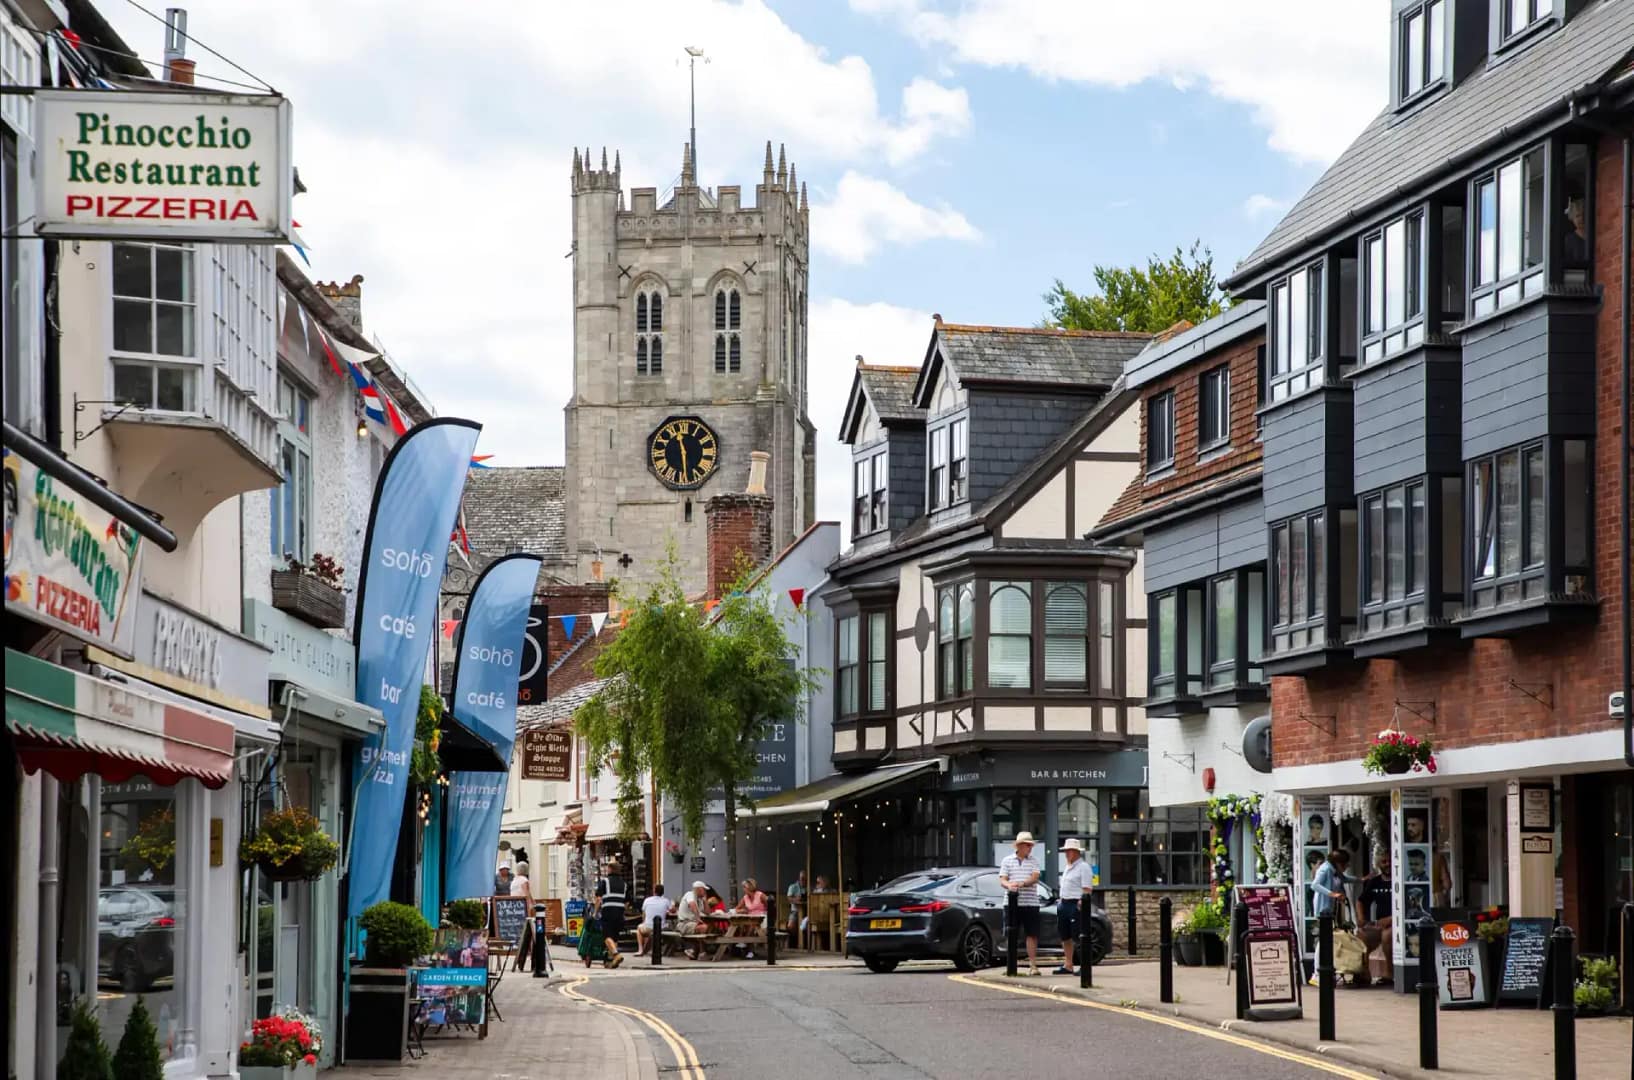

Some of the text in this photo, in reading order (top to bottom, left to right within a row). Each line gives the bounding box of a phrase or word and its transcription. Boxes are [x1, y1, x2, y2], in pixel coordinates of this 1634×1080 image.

[76, 112, 251, 149] Pinocchio
[67, 150, 261, 187] Restaurant
[66, 195, 258, 221] PIZZERIA
[35, 469, 119, 622] Restaurant
[36, 575, 100, 637] PIZZERIA
[380, 614, 415, 639] café
[381, 677, 401, 705] bar
[467, 692, 505, 709] café
[1031, 770, 1106, 779] BAR & KITCHEN
[459, 799, 490, 811] pizza
[1393, 815, 1401, 943] ANATOLIA
[1440, 926, 1470, 940] taste
